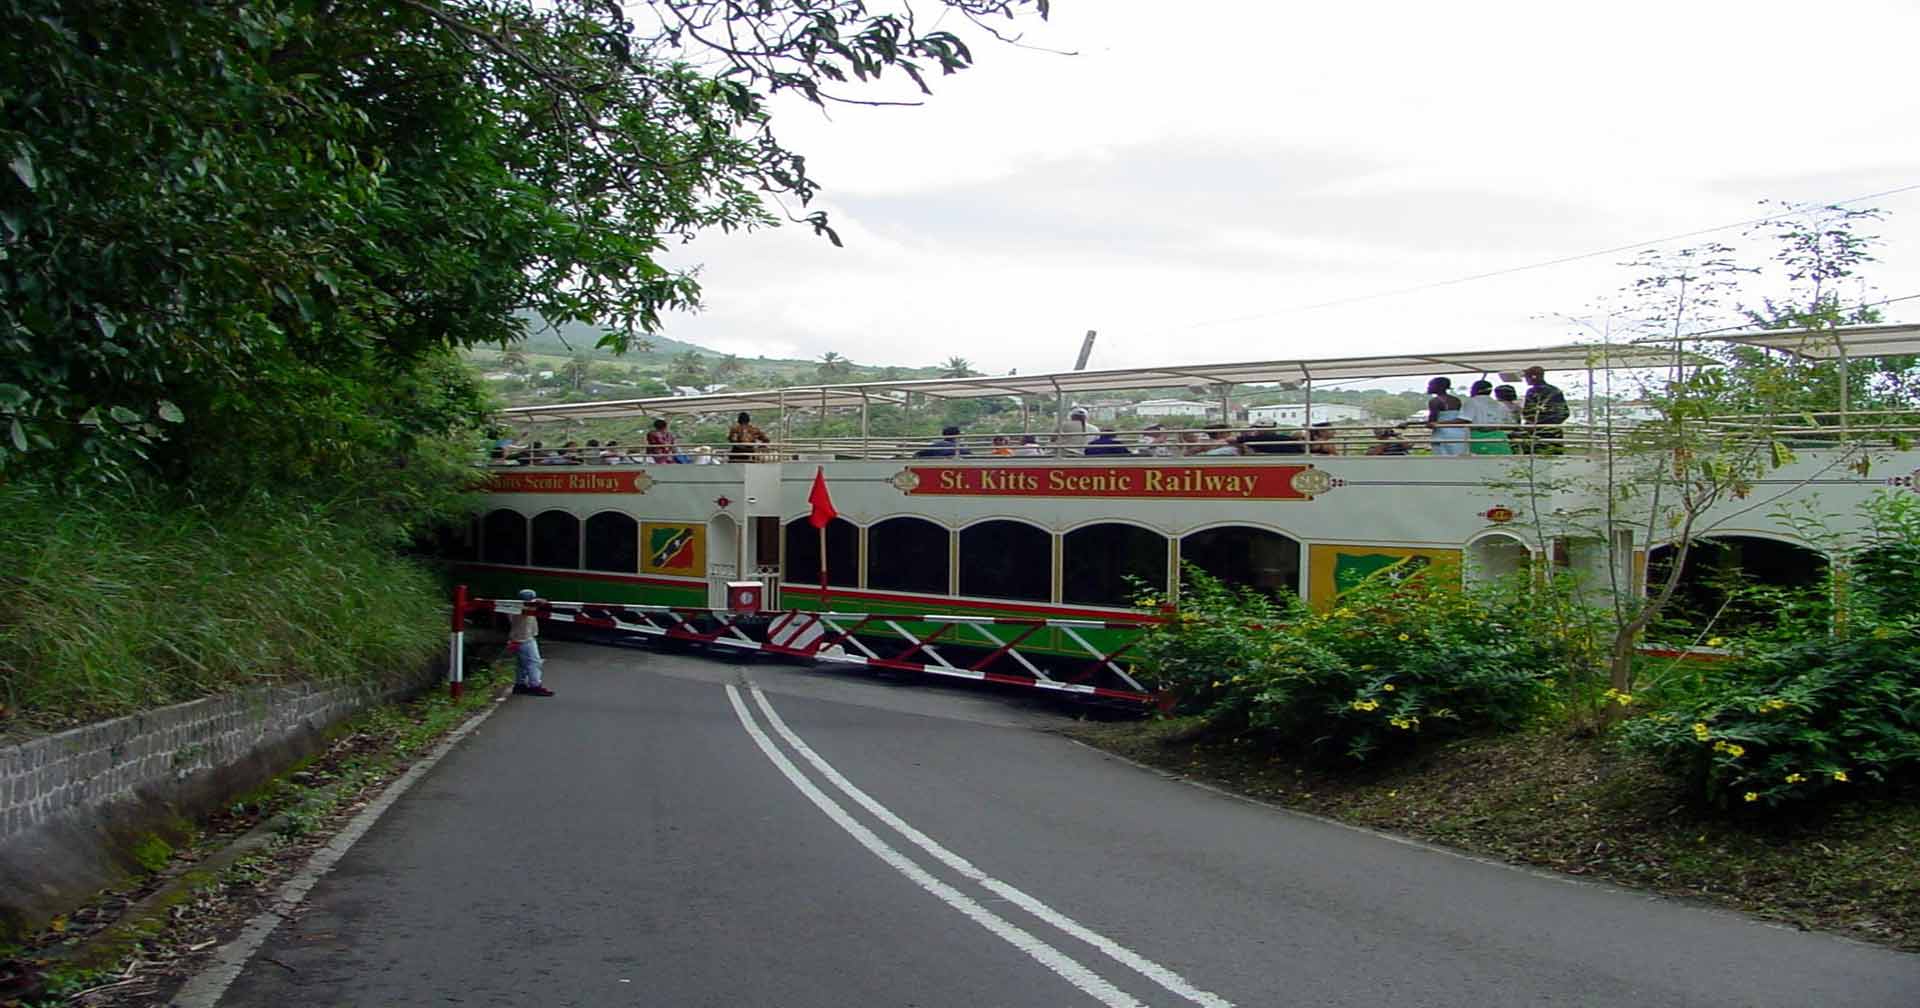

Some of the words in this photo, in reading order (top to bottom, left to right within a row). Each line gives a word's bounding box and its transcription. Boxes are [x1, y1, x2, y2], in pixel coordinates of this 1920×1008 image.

[569, 473, 619, 492] Railway
[940, 470, 970, 489] St.
[981, 470, 1039, 490] Kitts
[1049, 470, 1131, 491] Scenic
[1144, 469, 1258, 497] Railway
